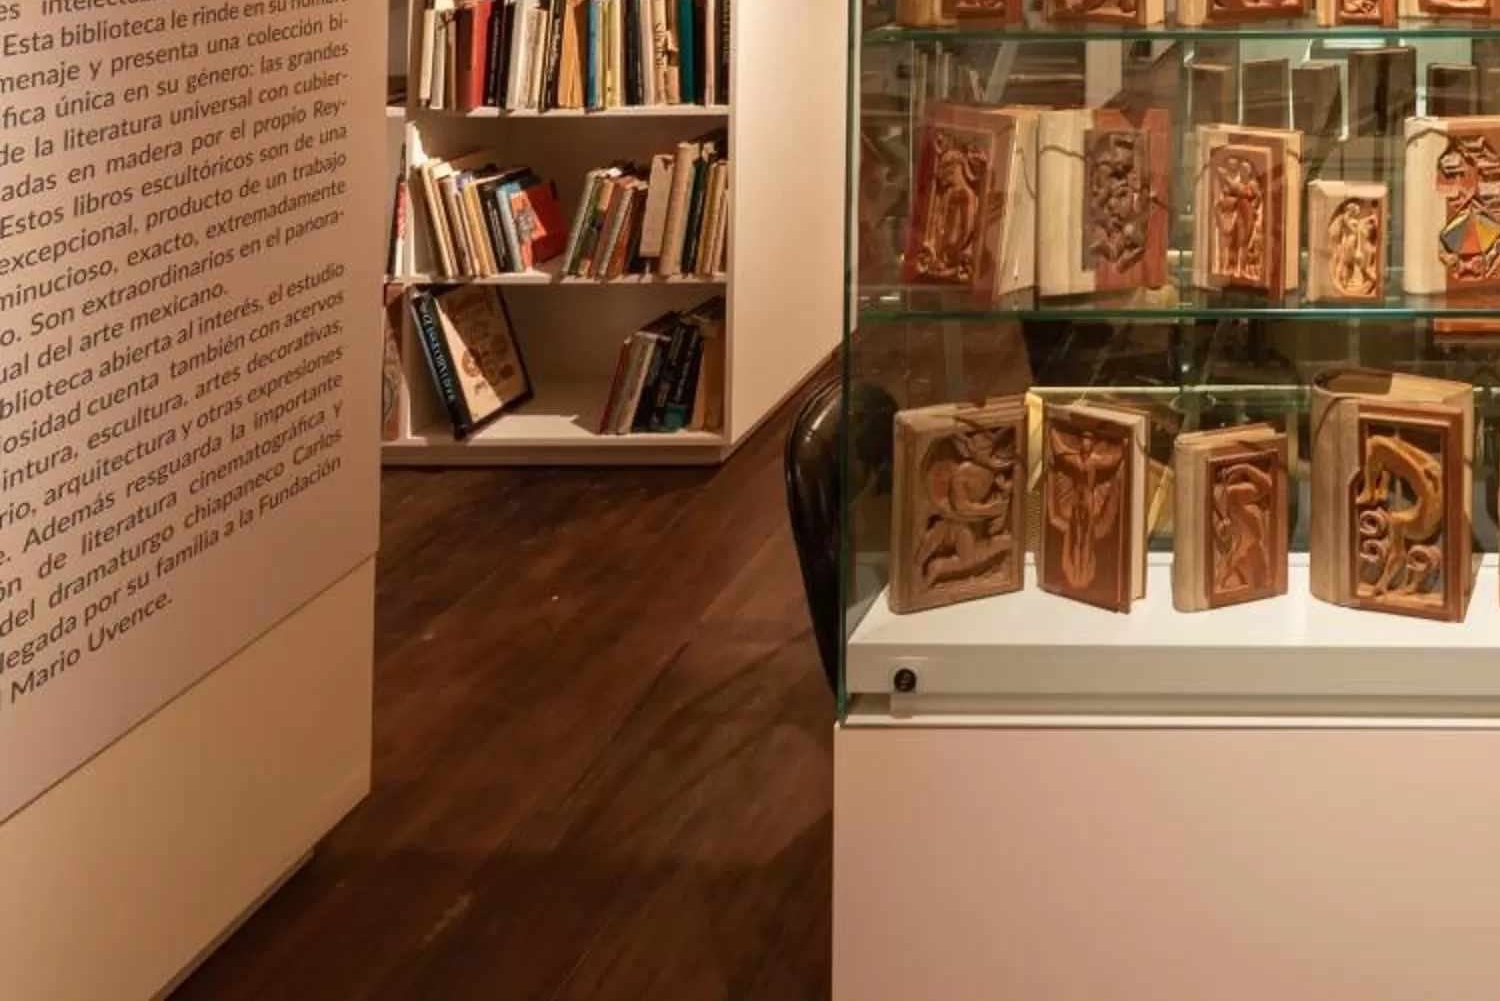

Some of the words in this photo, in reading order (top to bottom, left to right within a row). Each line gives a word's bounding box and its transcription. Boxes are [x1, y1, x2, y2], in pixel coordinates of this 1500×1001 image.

[3, 31, 54, 57] Esta
[60, 16, 166, 48] biblioteca
[170, 8, 188, 30] le
[191, 1, 239, 27] rinde
[242, 1, 264, 17] en
[88, 58, 102, 81] y
[110, 41, 199, 78] presenta
[206, 35, 240, 54] una
[246, 17, 323, 47] colección
[55, 90, 115, 118] única
[123, 84, 149, 103] en
[156, 78, 179, 97] su
[259, 54, 283, 75] las
[287, 41, 348, 71] grandes
[34, 135, 54, 159] la
[63, 113, 162, 151] literatura
[169, 86, 252, 126] universal
[257, 83, 288, 103] con
[66, 163, 95, 184] en
[105, 140, 183, 175] madera
[191, 129, 224, 155] por
[229, 118, 246, 140] el
[253, 106, 307, 140] propio
[0, 205, 64, 239] Estos
[73, 186, 133, 218] libros
[141, 151, 254, 197] escultóricos
[259, 142, 288, 162] son
[293, 133, 314, 151] de
[318, 125, 348, 145] una
[145, 188, 233, 232] producto
[238, 177, 260, 198] de
[265, 170, 287, 190] un
[292, 152, 347, 182] trabajo
[205, 180, 347, 239] extremadamente
[29, 306, 74, 336] Son
[81, 247, 234, 316] extraordinarios
[239, 238, 261, 258] en
[265, 227, 280, 248] el
[0, 367, 93, 421] blioteca
[98, 334, 172, 379] abierta
[176, 320, 194, 345] al
[266, 285, 283, 305] el
[286, 262, 345, 298] estudio
[37, 334, 72, 368] del
[79, 322, 124, 352] arte
[86, 371, 159, 416] cuenta
[168, 333, 245, 379] también
[248, 319, 280, 343] con
[282, 289, 344, 327] acervos
[194, 365, 241, 399] artes
[21, 490, 116, 553] Además
[125, 435, 222, 498] resguarda
[229, 423, 245, 443] la
[252, 374, 343, 431] importante
[43, 428, 176, 506] arquitectura
[180, 419, 192, 440] y
[196, 394, 243, 428] otras
[247, 345, 343, 403] expresiones
[37, 552, 68, 579] de
[80, 490, 177, 556] literatura
[187, 410, 326, 496] cinematográfica
[332, 398, 343, 419] y
[0, 597, 36, 637] del
[48, 523, 175, 609] dramaturgo
[182, 461, 285, 529] chiapaneco
[291, 429, 343, 468] Carlos
[83, 587, 122, 627] por
[126, 570, 149, 596] su
[155, 529, 219, 578] familia
[223, 520, 235, 537] a
[238, 508, 254, 528] la
[258, 457, 341, 518] Fundación
[10, 647, 80, 703] Mario
